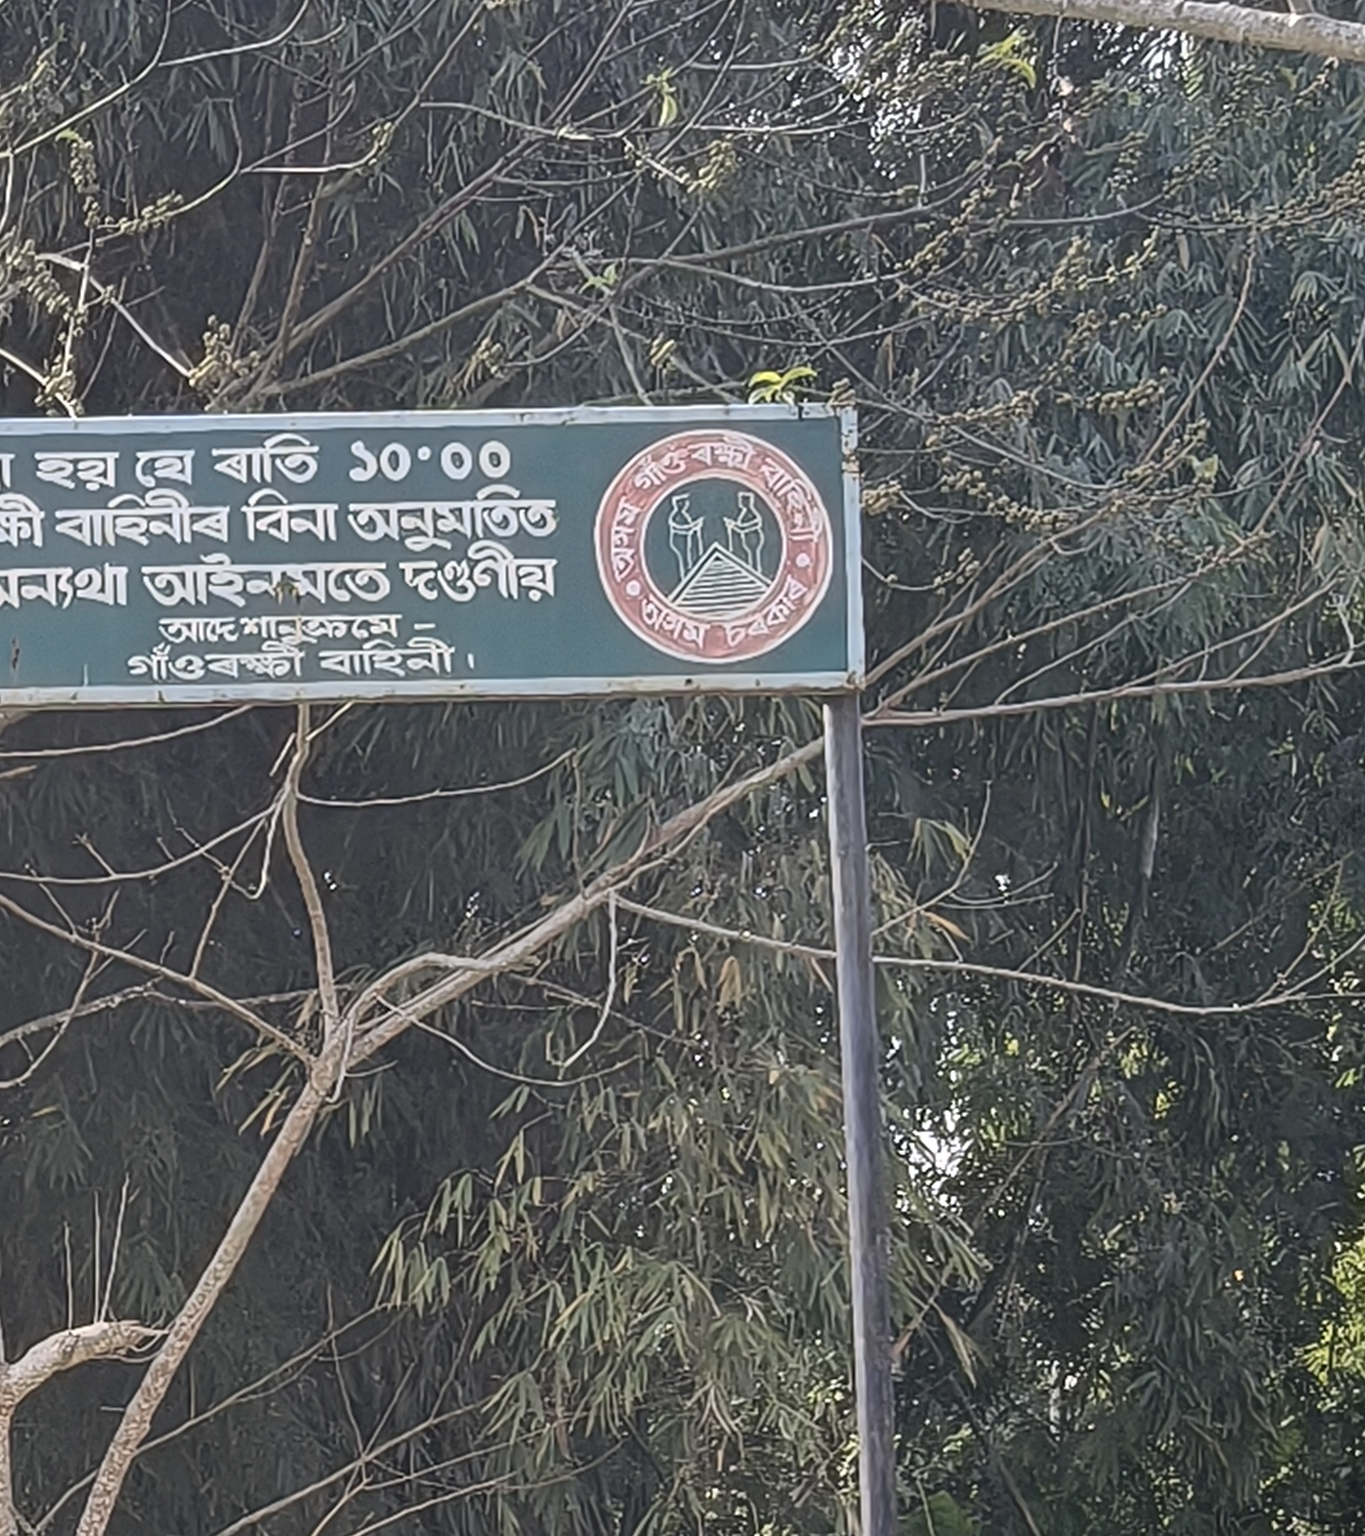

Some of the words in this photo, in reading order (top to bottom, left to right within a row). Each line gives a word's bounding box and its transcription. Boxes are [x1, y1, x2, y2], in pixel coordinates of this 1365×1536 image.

[34, 451, 119, 492] হয়
[212, 433, 319, 484] ৰাতি
[55, 488, 230, 548] বাহিনীৰ
[242, 488, 338, 542] বিনা
[348, 485, 558, 550] অনুমতিত
[141, 553, 390, 607] আইনমতে
